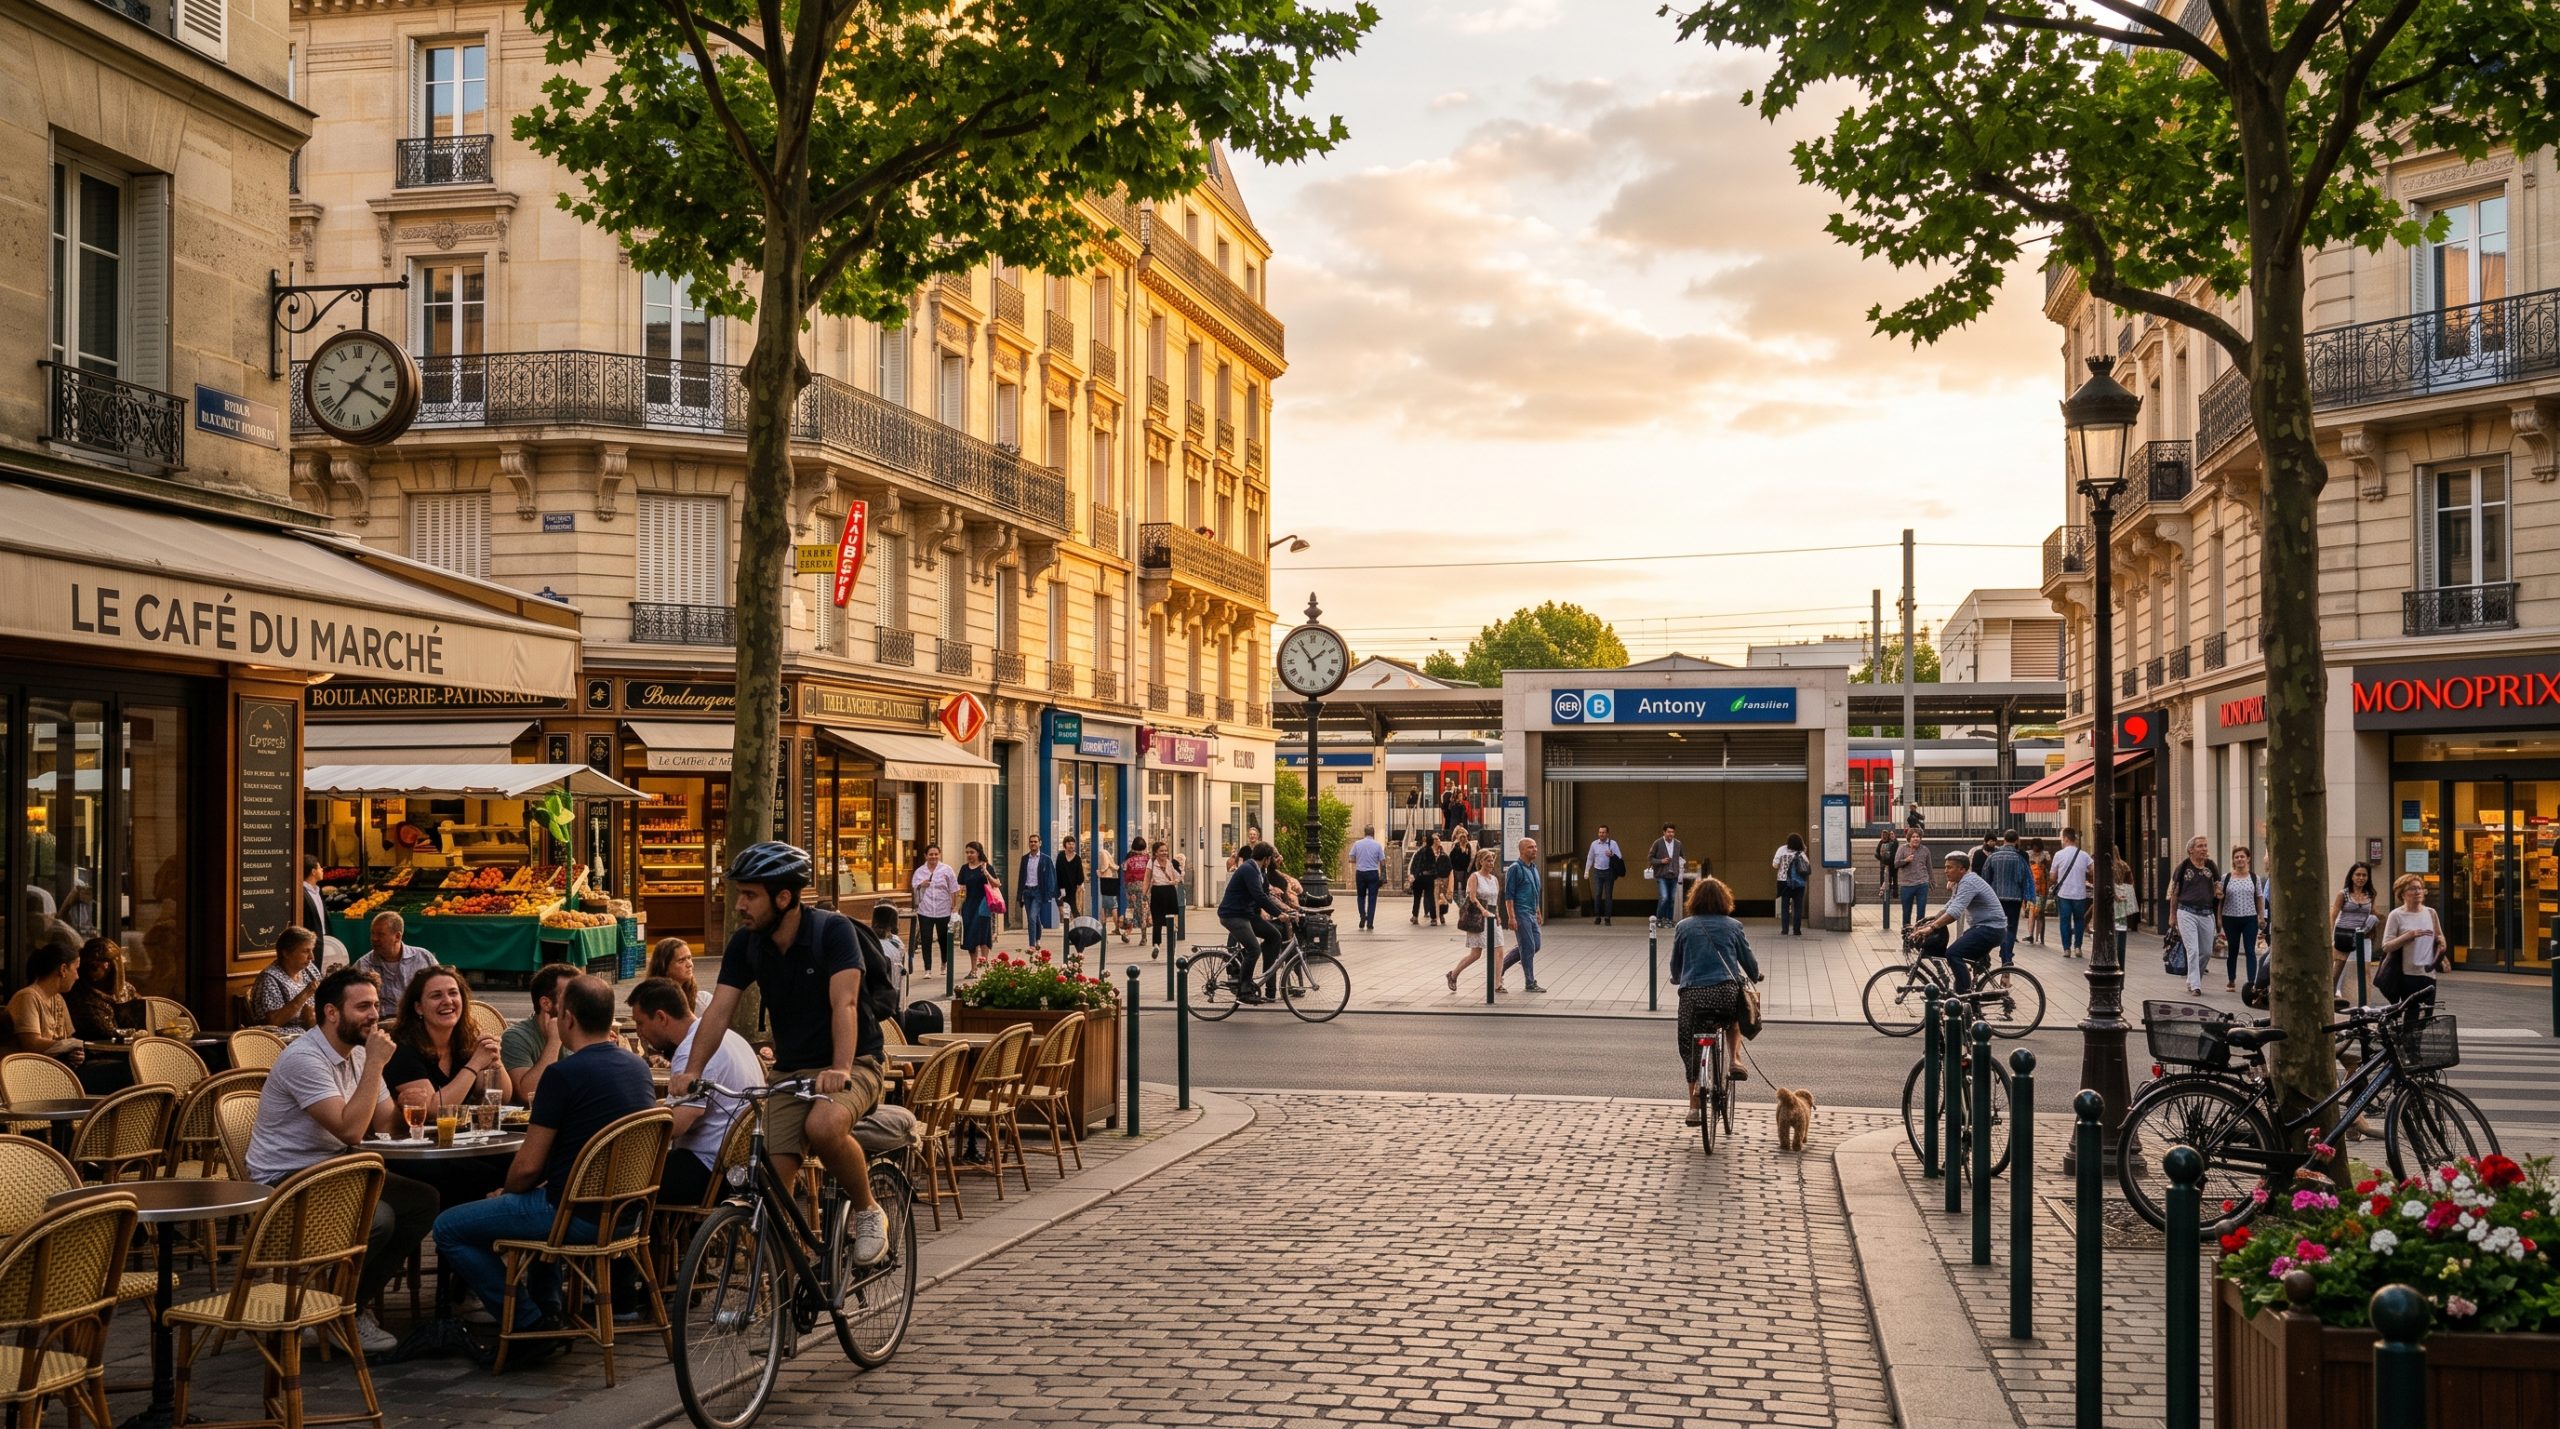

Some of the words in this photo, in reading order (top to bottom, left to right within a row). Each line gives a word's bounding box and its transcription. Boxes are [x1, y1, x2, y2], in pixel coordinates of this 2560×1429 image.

[72, 583, 120, 636] LE
[135, 592, 237, 650] CAFÉ
[250, 610, 298, 658] DU
[311, 619, 444, 675] MARCHÉ
[1559, 701, 1578, 712] RER
[1593, 699, 1605, 714] B
[1638, 697, 1706, 717] Antony
[2352, 673, 2560, 713] MONOPRIX
[2219, 695, 2264, 728] MONOPRIX
